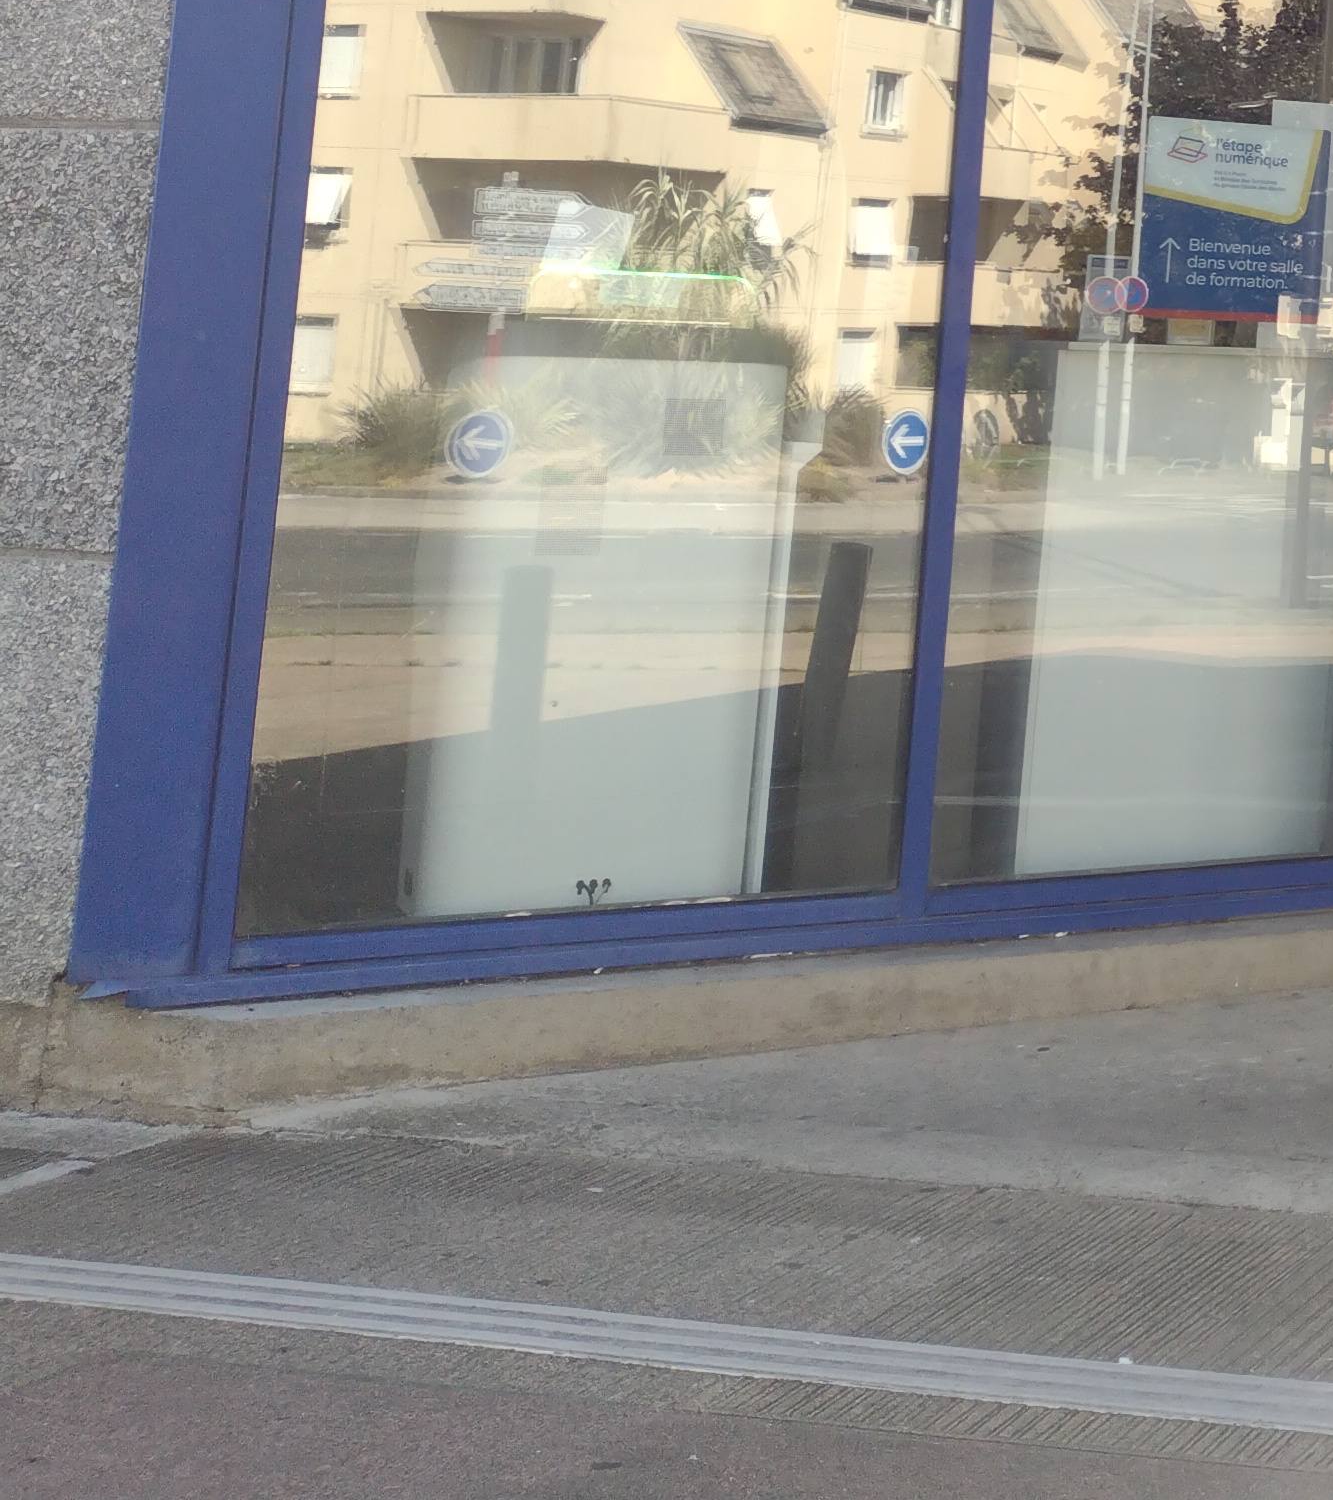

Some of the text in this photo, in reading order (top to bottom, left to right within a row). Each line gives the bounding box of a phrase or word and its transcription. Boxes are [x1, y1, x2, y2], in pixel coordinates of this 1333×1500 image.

[1216, 137, 1263, 155] l'étape
[1215, 151, 1289, 169] numérique
[1188, 237, 1271, 256] Bienvenue
[1187, 254, 1304, 274] dans votre salle
[1185, 271, 1288, 290] de formation.
